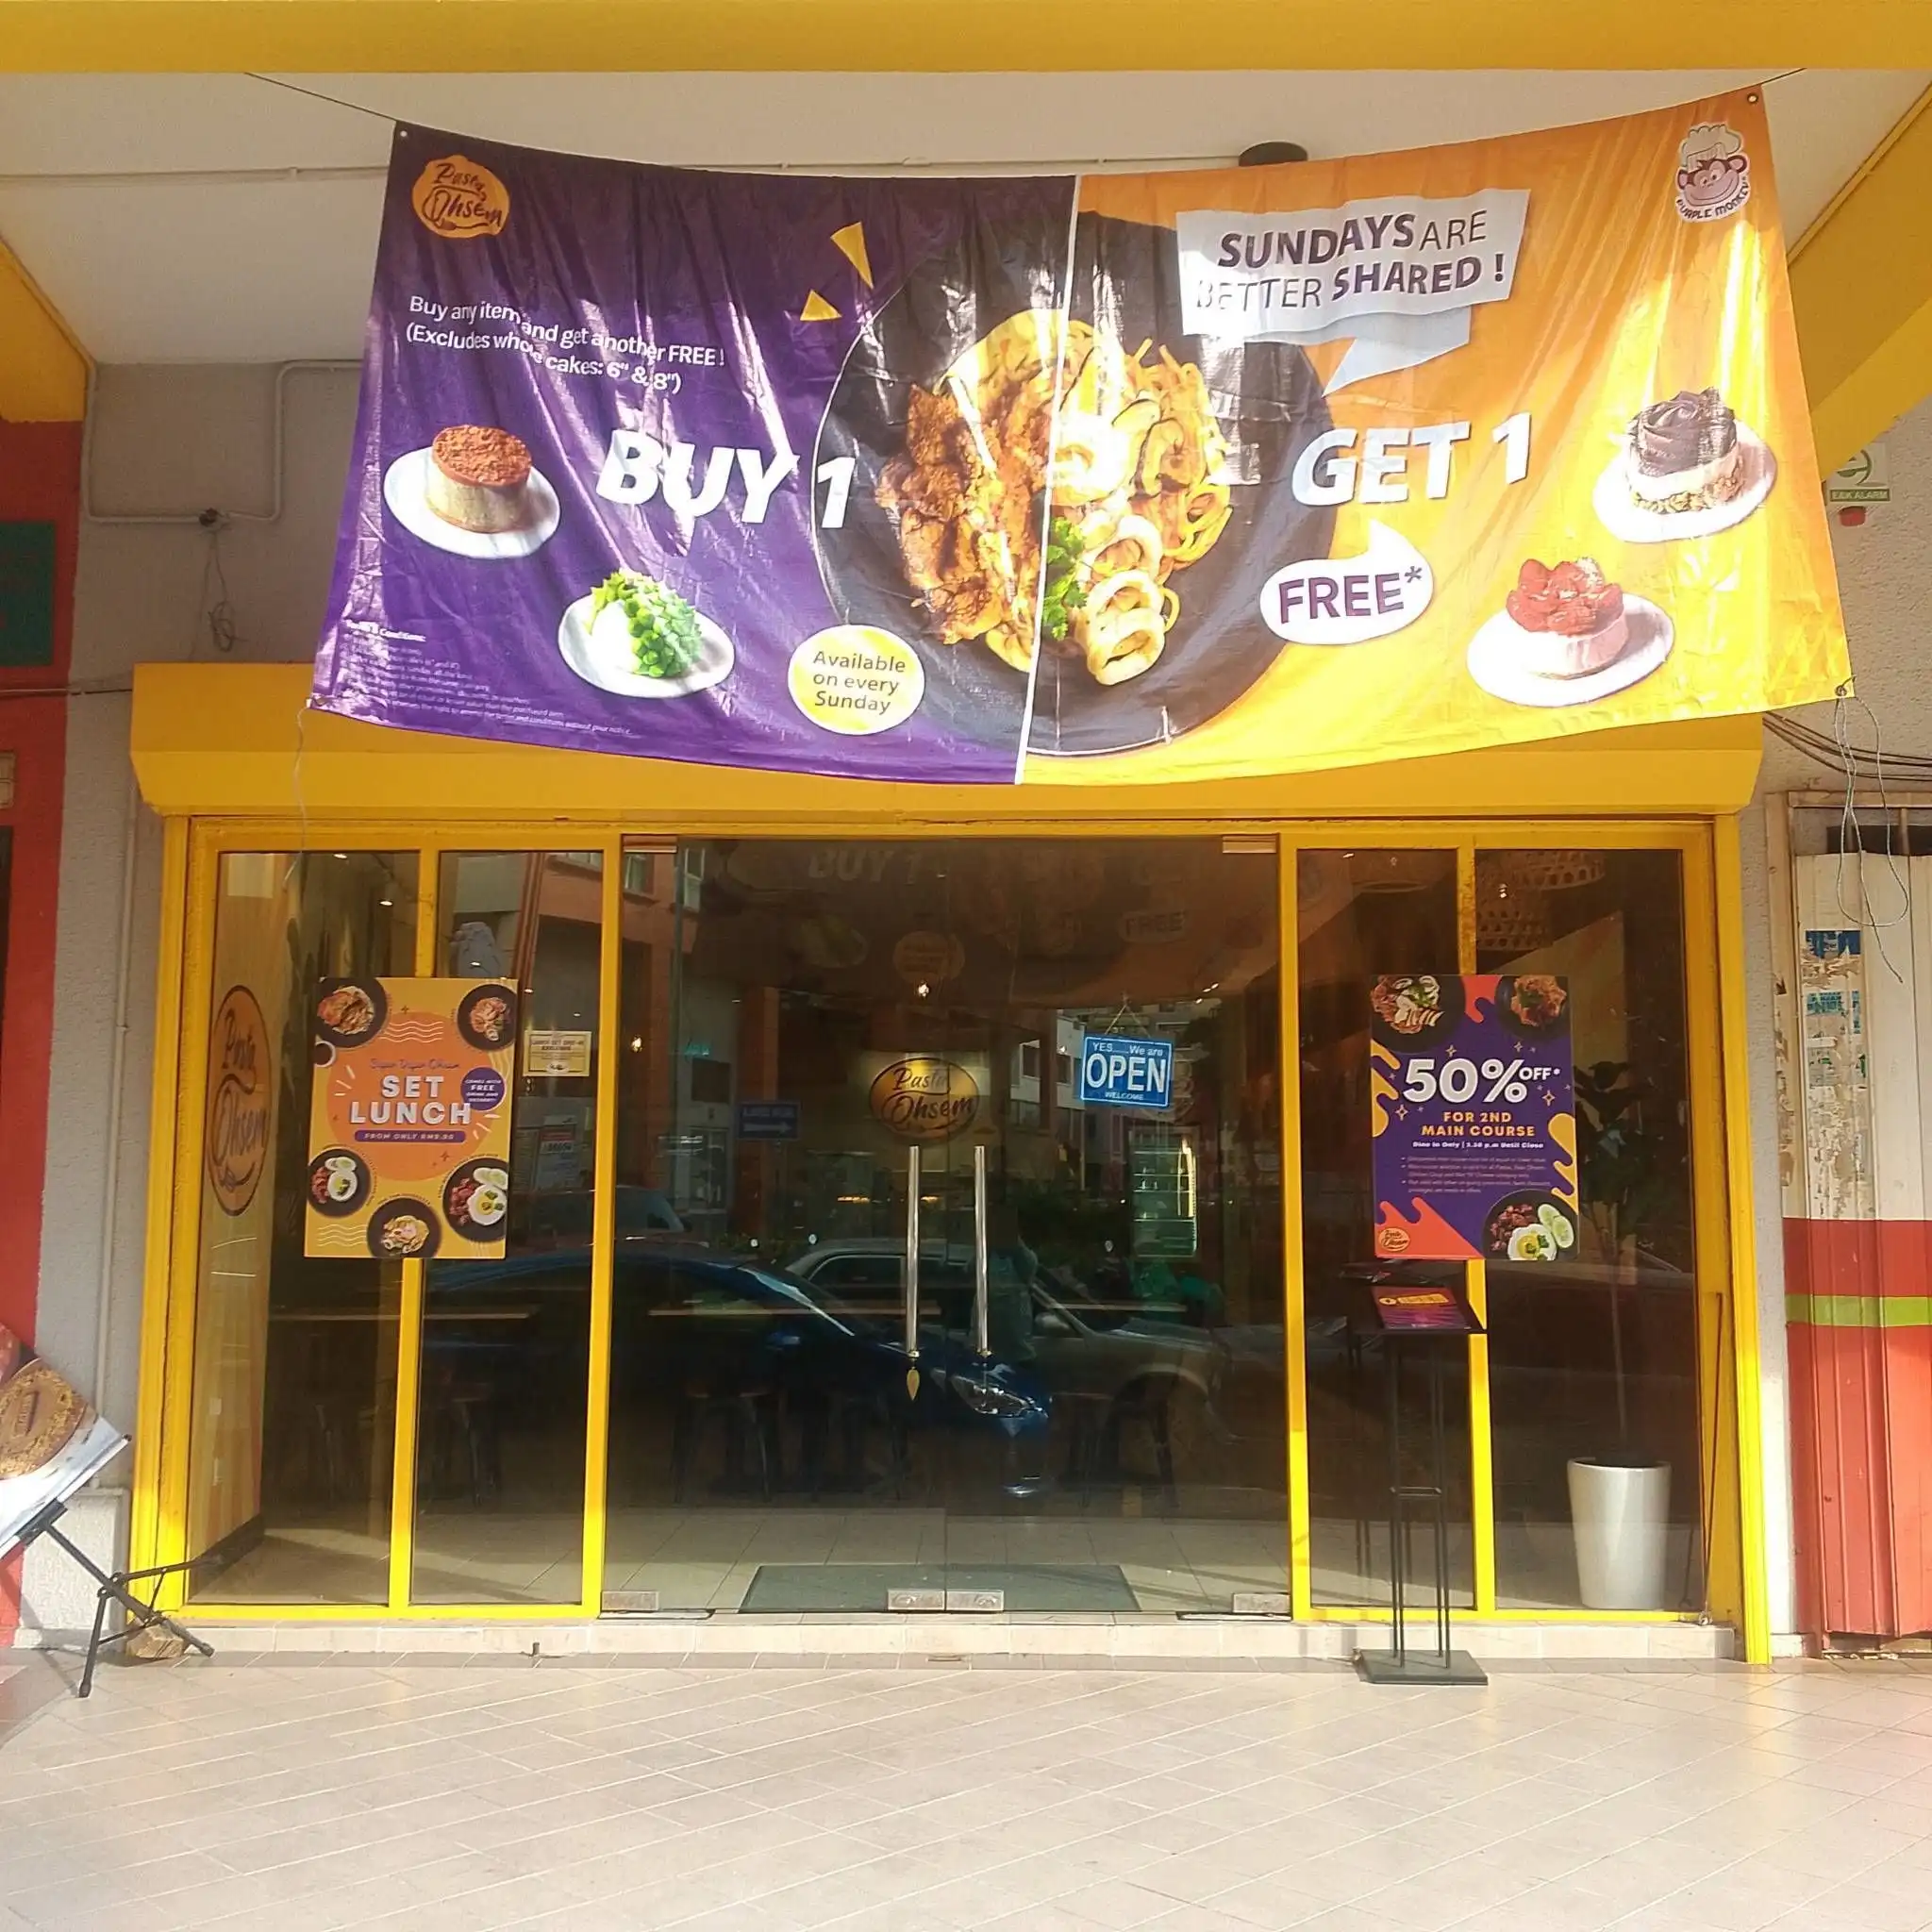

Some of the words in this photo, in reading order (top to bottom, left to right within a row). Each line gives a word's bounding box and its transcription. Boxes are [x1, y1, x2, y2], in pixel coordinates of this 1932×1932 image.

[1218, 213, 1417, 270] SUNDAYS
[1419, 209, 1488, 251] ARE
[1331, 255, 1482, 301] SHARED
[409, 295, 449, 323] Buy
[450, 305, 478, 325] any
[479, 300, 522, 325] item
[521, 324, 559, 342] and
[559, 327, 590, 349] get
[591, 334, 667, 362] another
[667, 343, 717, 367] FREE
[406, 322, 491, 350] (Excludes
[493, 331, 544, 364] whoe
[544, 355, 604, 375] cakes:
[631, 366, 651, 387] &
[1291, 421, 1472, 507] GET
[1491, 411, 1532, 485] 1
[596, 429, 800, 525] BUY
[817, 457, 857, 529] 1
[812, 649, 907, 674] Available
[812, 673, 839, 687] on
[843, 676, 900, 696] every
[814, 690, 891, 716] Sunday
[381, 1074, 445, 1099] SET
[1086, 1053, 1167, 1093] OPEN
[1403, 1058, 1528, 1104] 50%
[1105, 1091, 1144, 1101] WELCOME
[349, 1101, 472, 1125] LUNCH
[1443, 1111, 1474, 1123] FOR
[1479, 1111, 1512, 1123] 2ND
[1421, 1124, 1464, 1137] MAIN
[1470, 1125, 1535, 1137] COURSE
